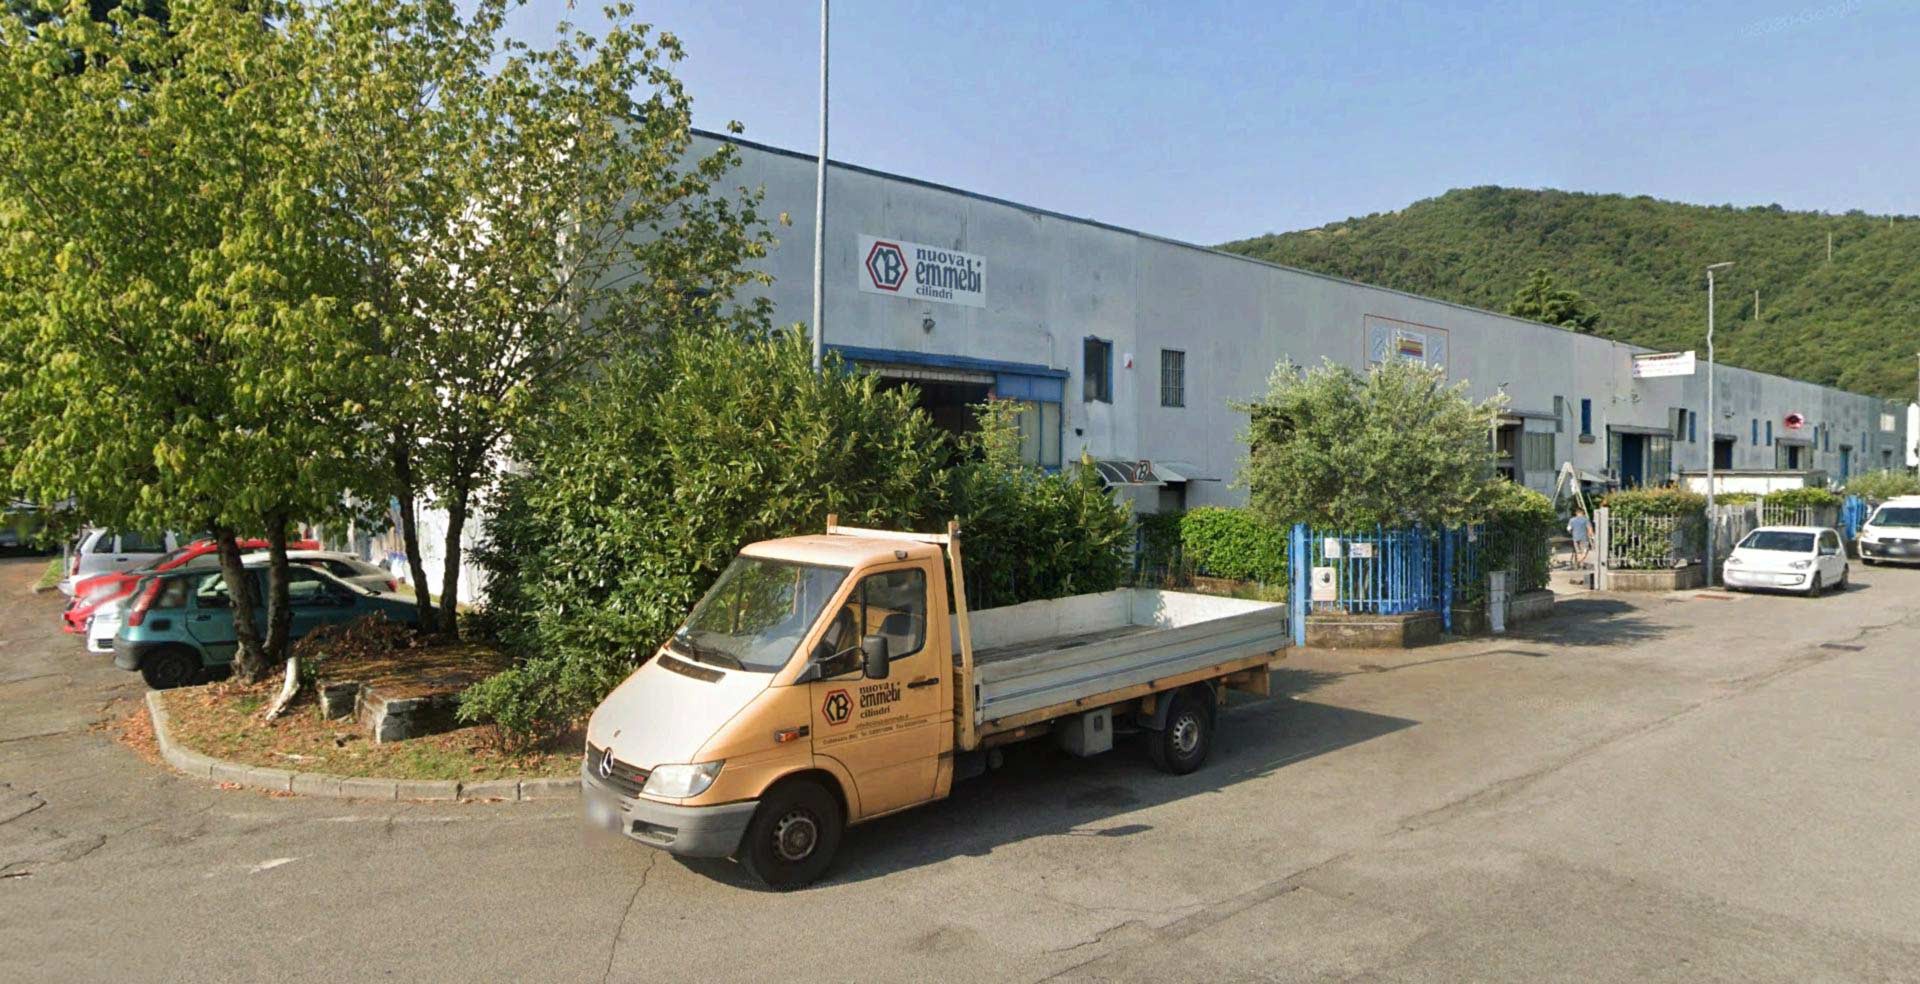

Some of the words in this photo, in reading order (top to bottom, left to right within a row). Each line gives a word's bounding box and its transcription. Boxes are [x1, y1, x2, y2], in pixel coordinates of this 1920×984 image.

[916, 248, 964, 267] nuova
[916, 260, 981, 293] emmebi
[916, 286, 953, 299] cilindri
[859, 682, 889, 695] nuova
[860, 682, 901, 708] emmebi
[860, 705, 891, 719] cilindri
